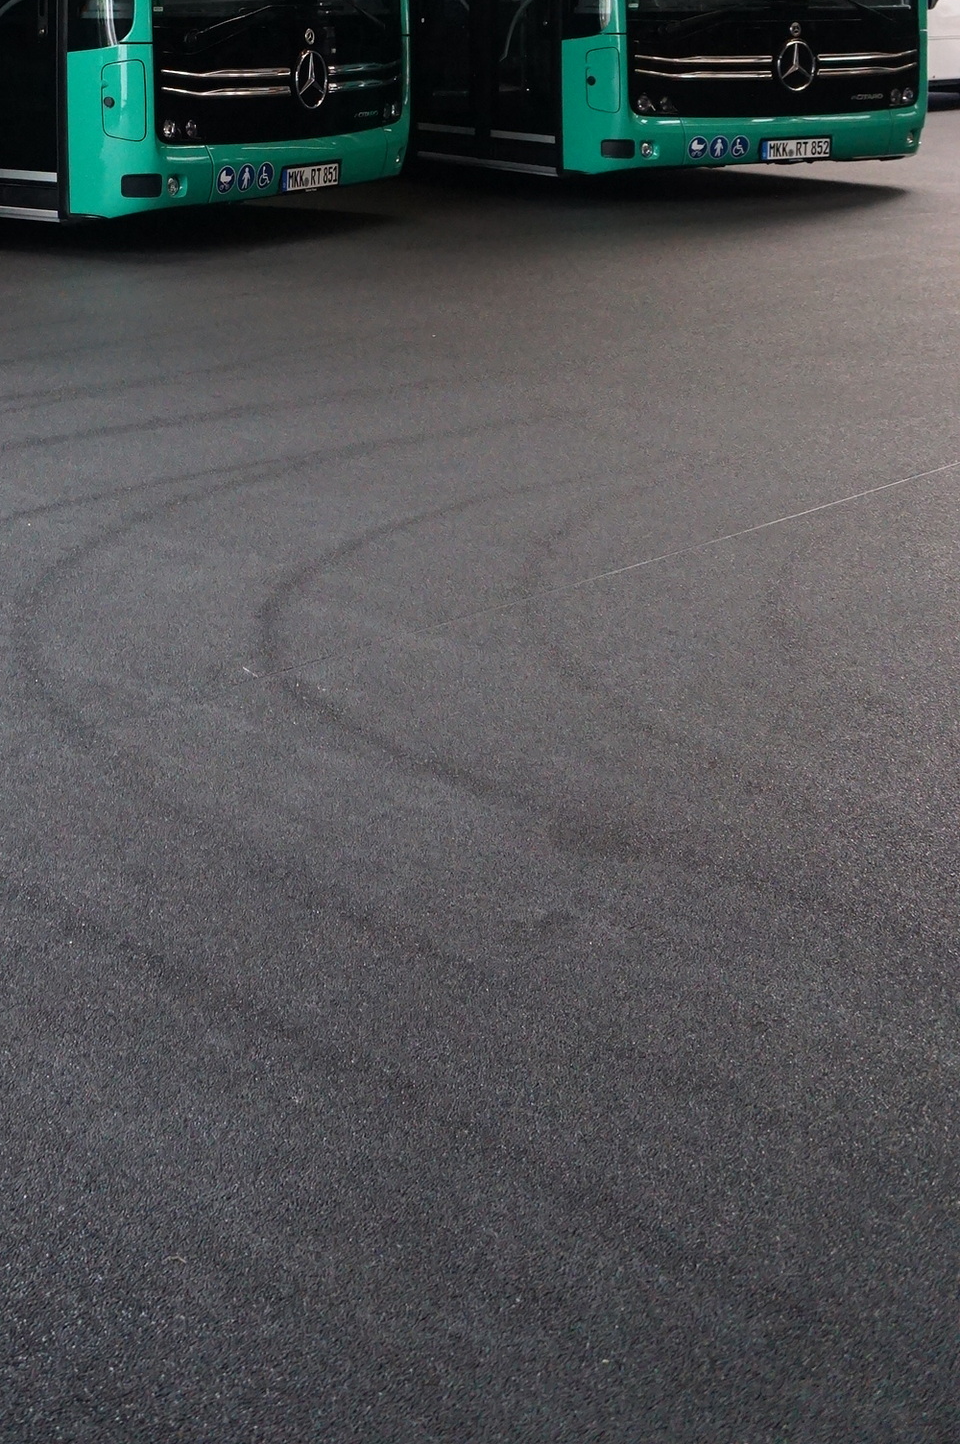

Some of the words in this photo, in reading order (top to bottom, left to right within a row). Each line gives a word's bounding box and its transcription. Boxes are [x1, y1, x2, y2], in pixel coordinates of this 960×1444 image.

[768, 142, 789, 157] MKK
[795, 141, 809, 156] RT
[810, 140, 829, 155] 852
[288, 169, 305, 188] MKK
[310, 167, 322, 185] RT
[323, 165, 338, 184] 851
